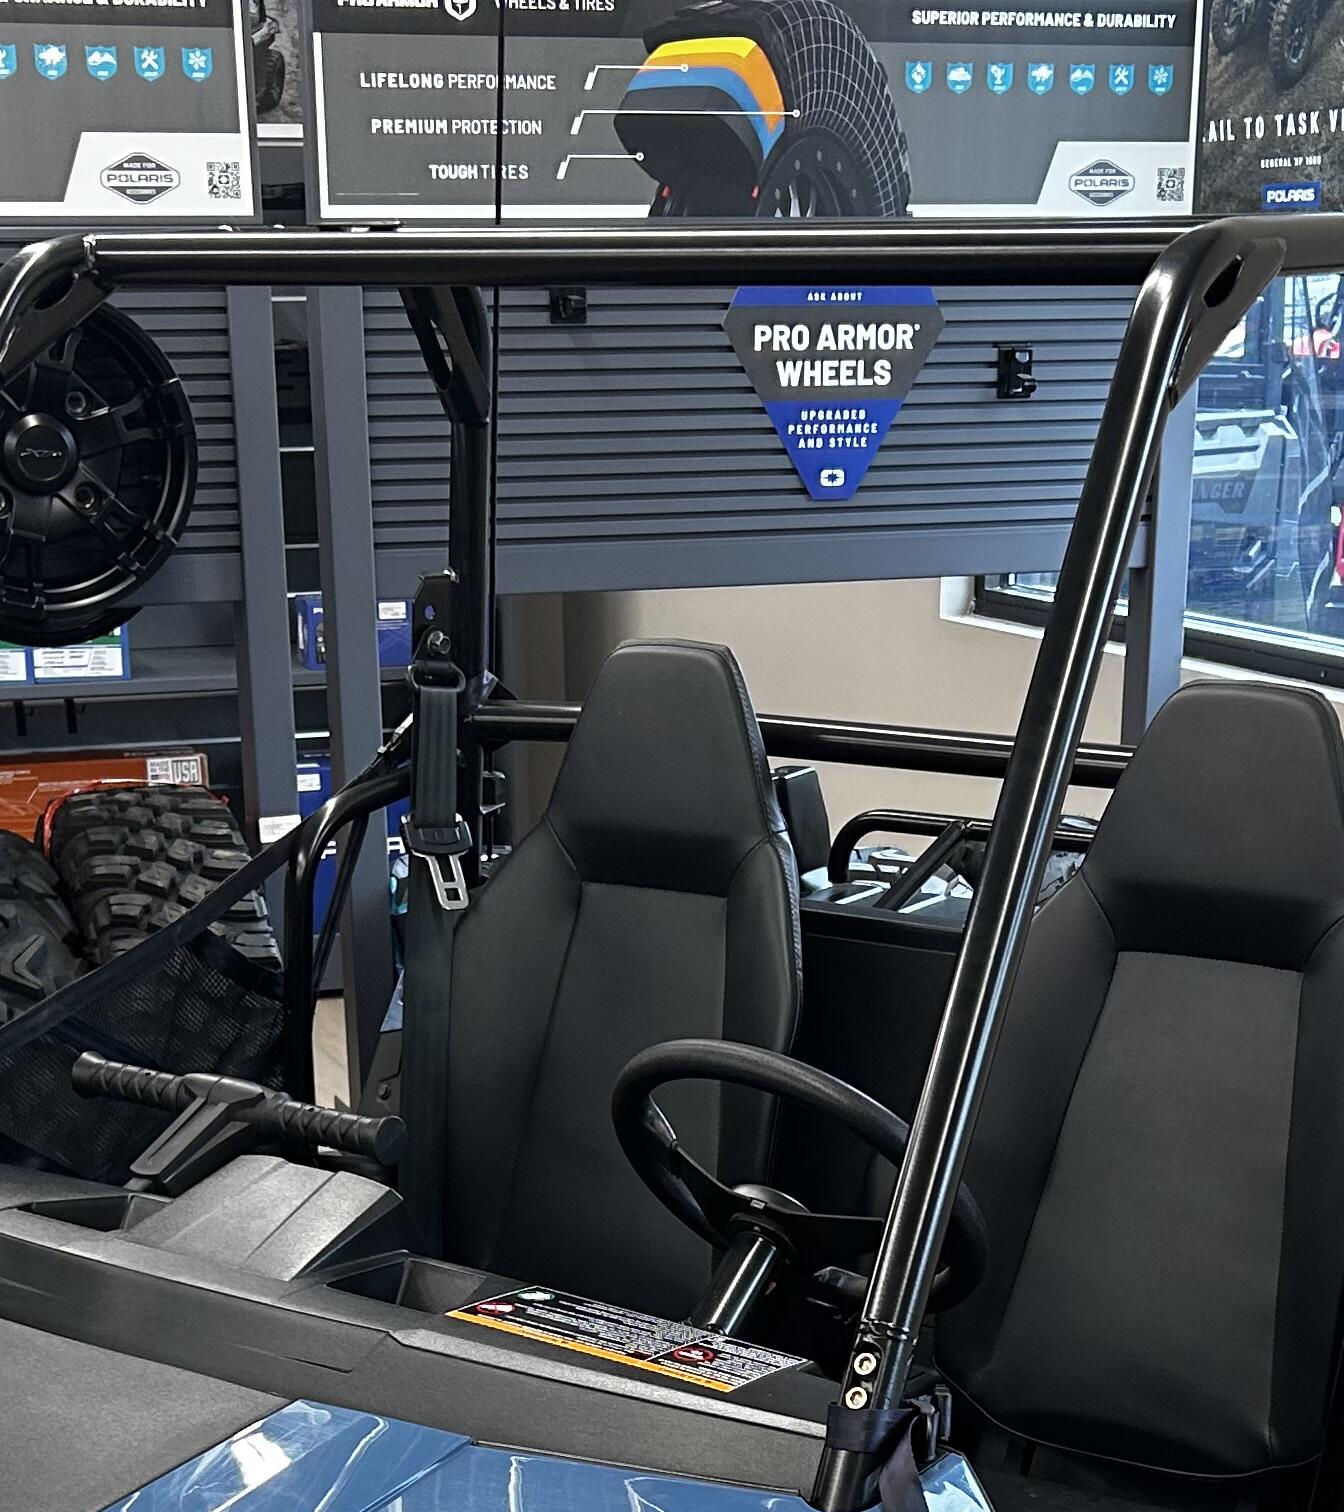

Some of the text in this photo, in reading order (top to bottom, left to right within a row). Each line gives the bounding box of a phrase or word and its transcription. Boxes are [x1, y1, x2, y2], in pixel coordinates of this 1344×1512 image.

[912, 9, 1177, 29] SUPERIOR PERFORMANCE & DURABILITY
[359, 72, 557, 90] LIFELONG PERFOMANCE
[371, 118, 448, 135] PREMIUM
[1203, 119, 1236, 143] AIL
[1244, 116, 1265, 139] TO
[1274, 111, 1320, 136] TASK
[107, 174, 173, 183] POLARIS
[428, 164, 478, 180] TOUGH
[1074, 179, 1129, 188] POLARIS
[1266, 188, 1315, 203] POLARIS
[807, 292, 863, 301] ASK ABOUT
[754, 324, 810, 351] PRO
[776, 360, 892, 387] WHEELS
[800, 409, 866, 421] UPGRADED
[788, 423, 878, 435] PERFORMANCE
[798, 437, 867, 449] AND STYLE
[174, 760, 199, 783] USA
